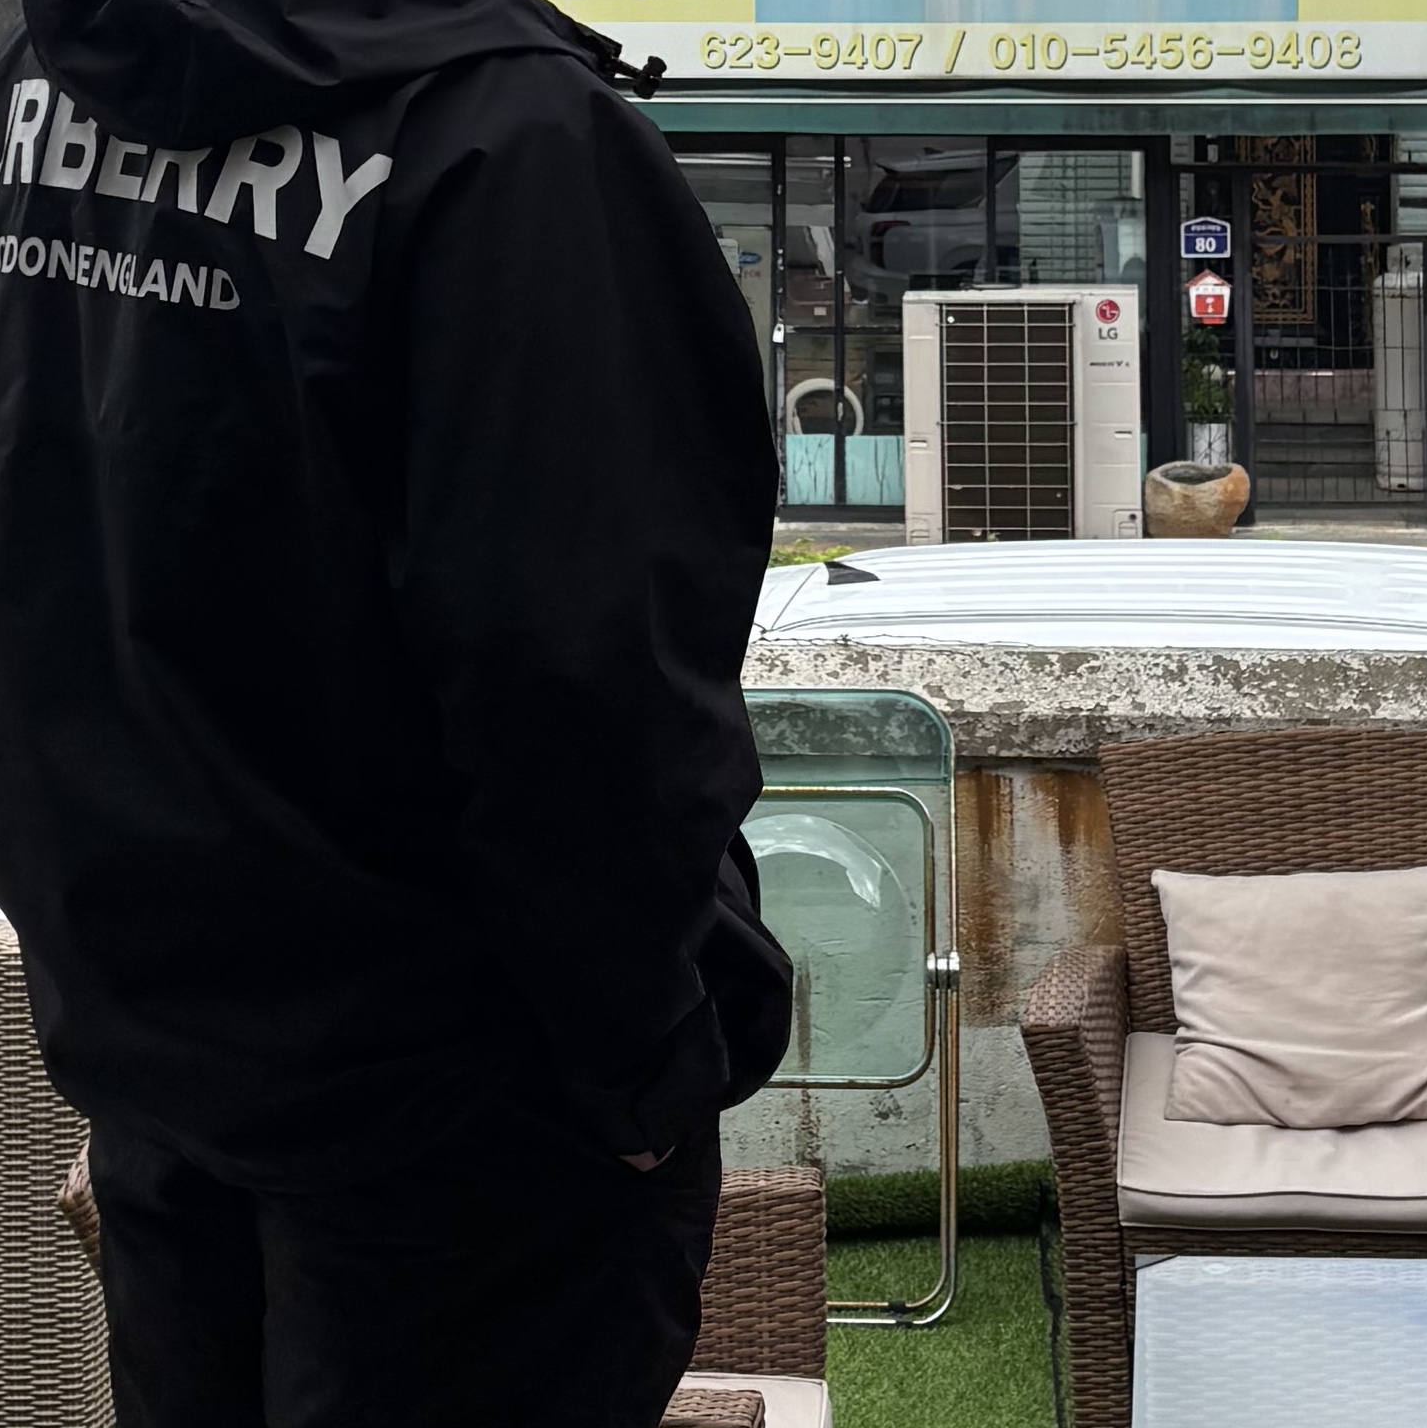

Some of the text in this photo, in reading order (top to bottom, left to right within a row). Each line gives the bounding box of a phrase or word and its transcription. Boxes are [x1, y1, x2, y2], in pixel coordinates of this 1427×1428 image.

[699, 31, 923, 71] 623-9407
[988, 30, 1363, 71] 010-5456-9408
[1195, 236, 1217, 253] 80
[1098, 327, 1119, 340] LG
